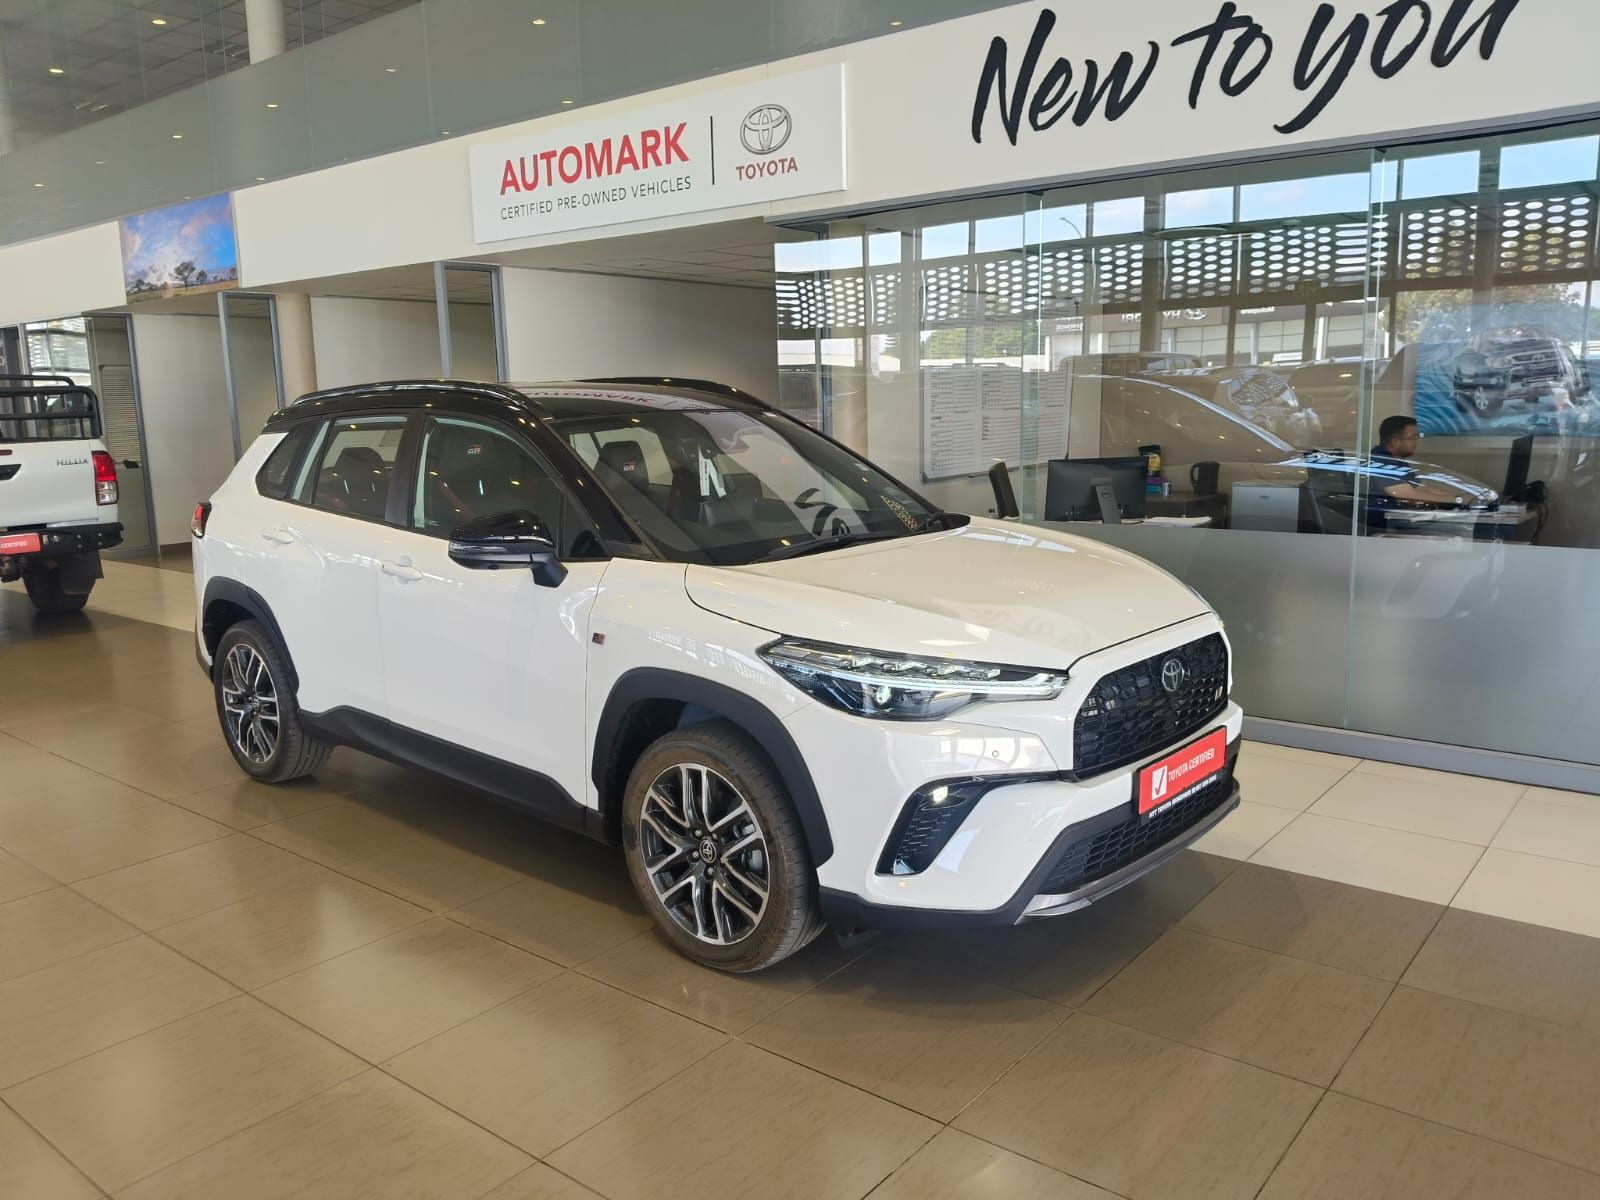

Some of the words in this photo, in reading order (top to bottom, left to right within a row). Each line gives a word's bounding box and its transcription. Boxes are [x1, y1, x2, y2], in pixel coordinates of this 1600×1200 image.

[971, 8, 1160, 146] New
[1171, 1, 1273, 109] to
[1273, 0, 1519, 134] you
[500, 121, 690, 196] AUTOMARK
[735, 157, 798, 181] TOYOTA
[500, 200, 553, 221] CERTIFIED
[557, 187, 627, 211] PRE-OWNED
[631, 175, 692, 198] VEHICLES
[1168, 763, 1189, 783] TOYOTA
[1189, 747, 1215, 770] CERTIFIED
